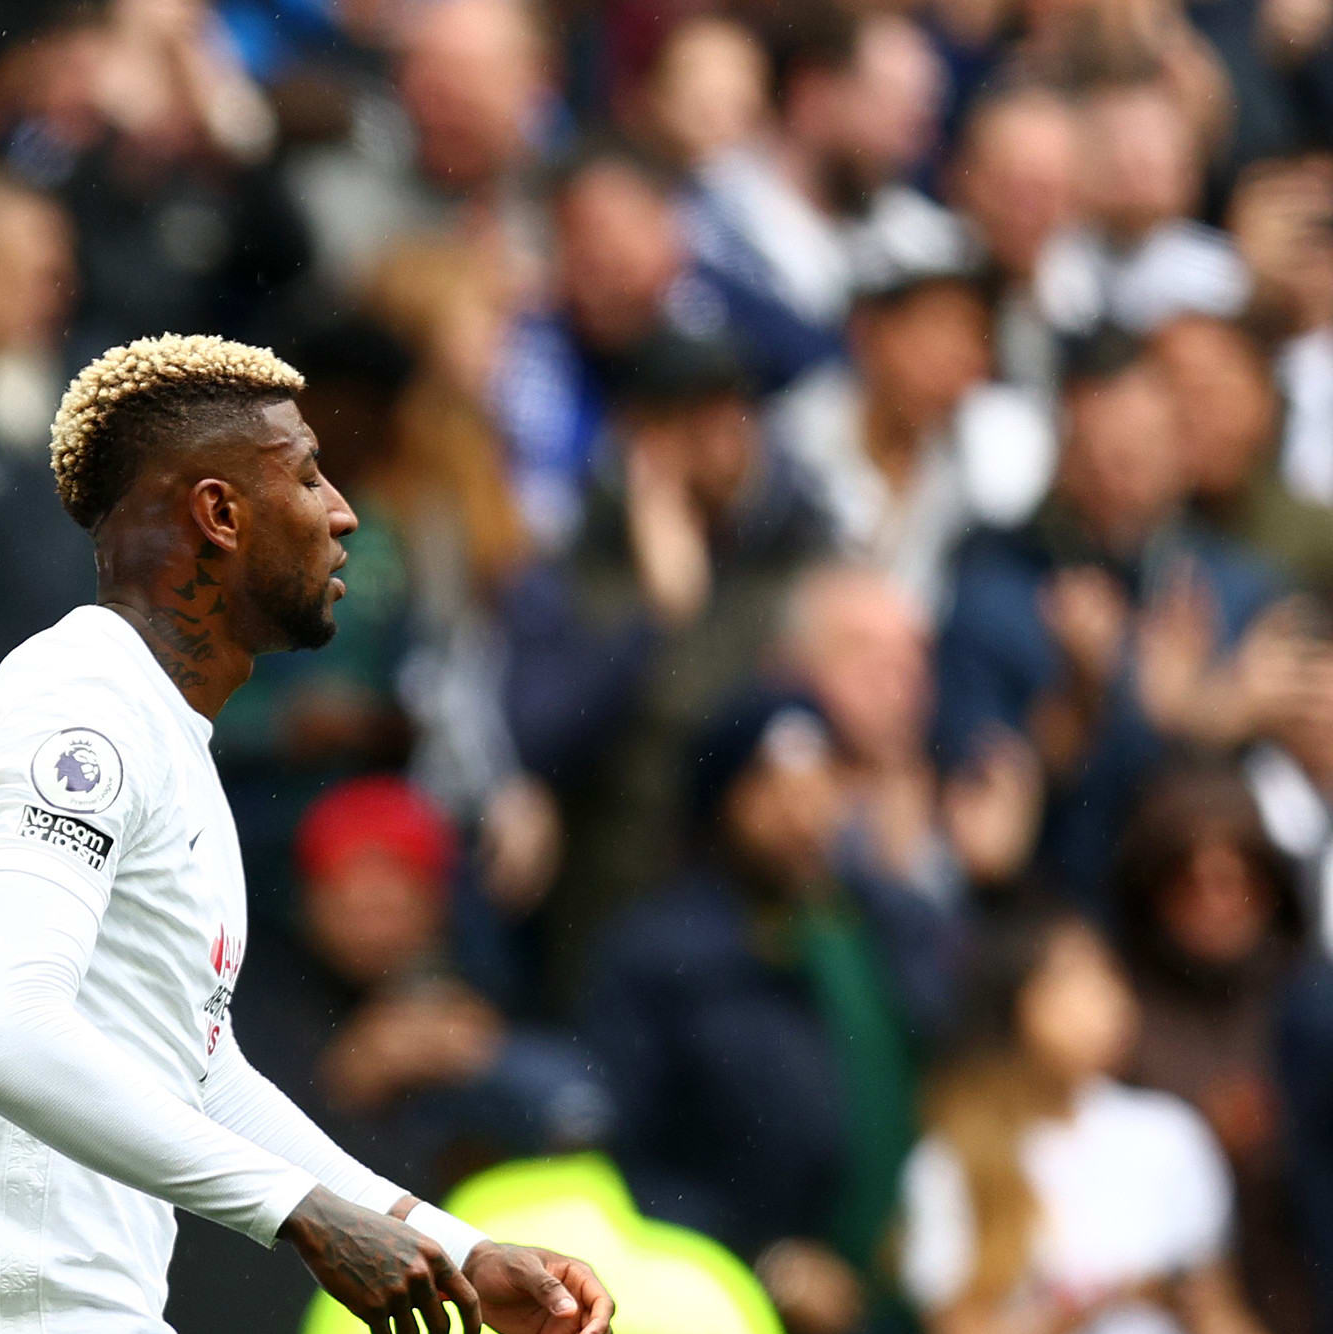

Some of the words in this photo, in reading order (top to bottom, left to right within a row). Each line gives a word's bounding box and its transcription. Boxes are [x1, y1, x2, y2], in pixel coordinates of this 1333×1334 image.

[23, 806, 53, 828] No
[54, 817, 104, 852] room
[48, 831, 105, 872] racism
